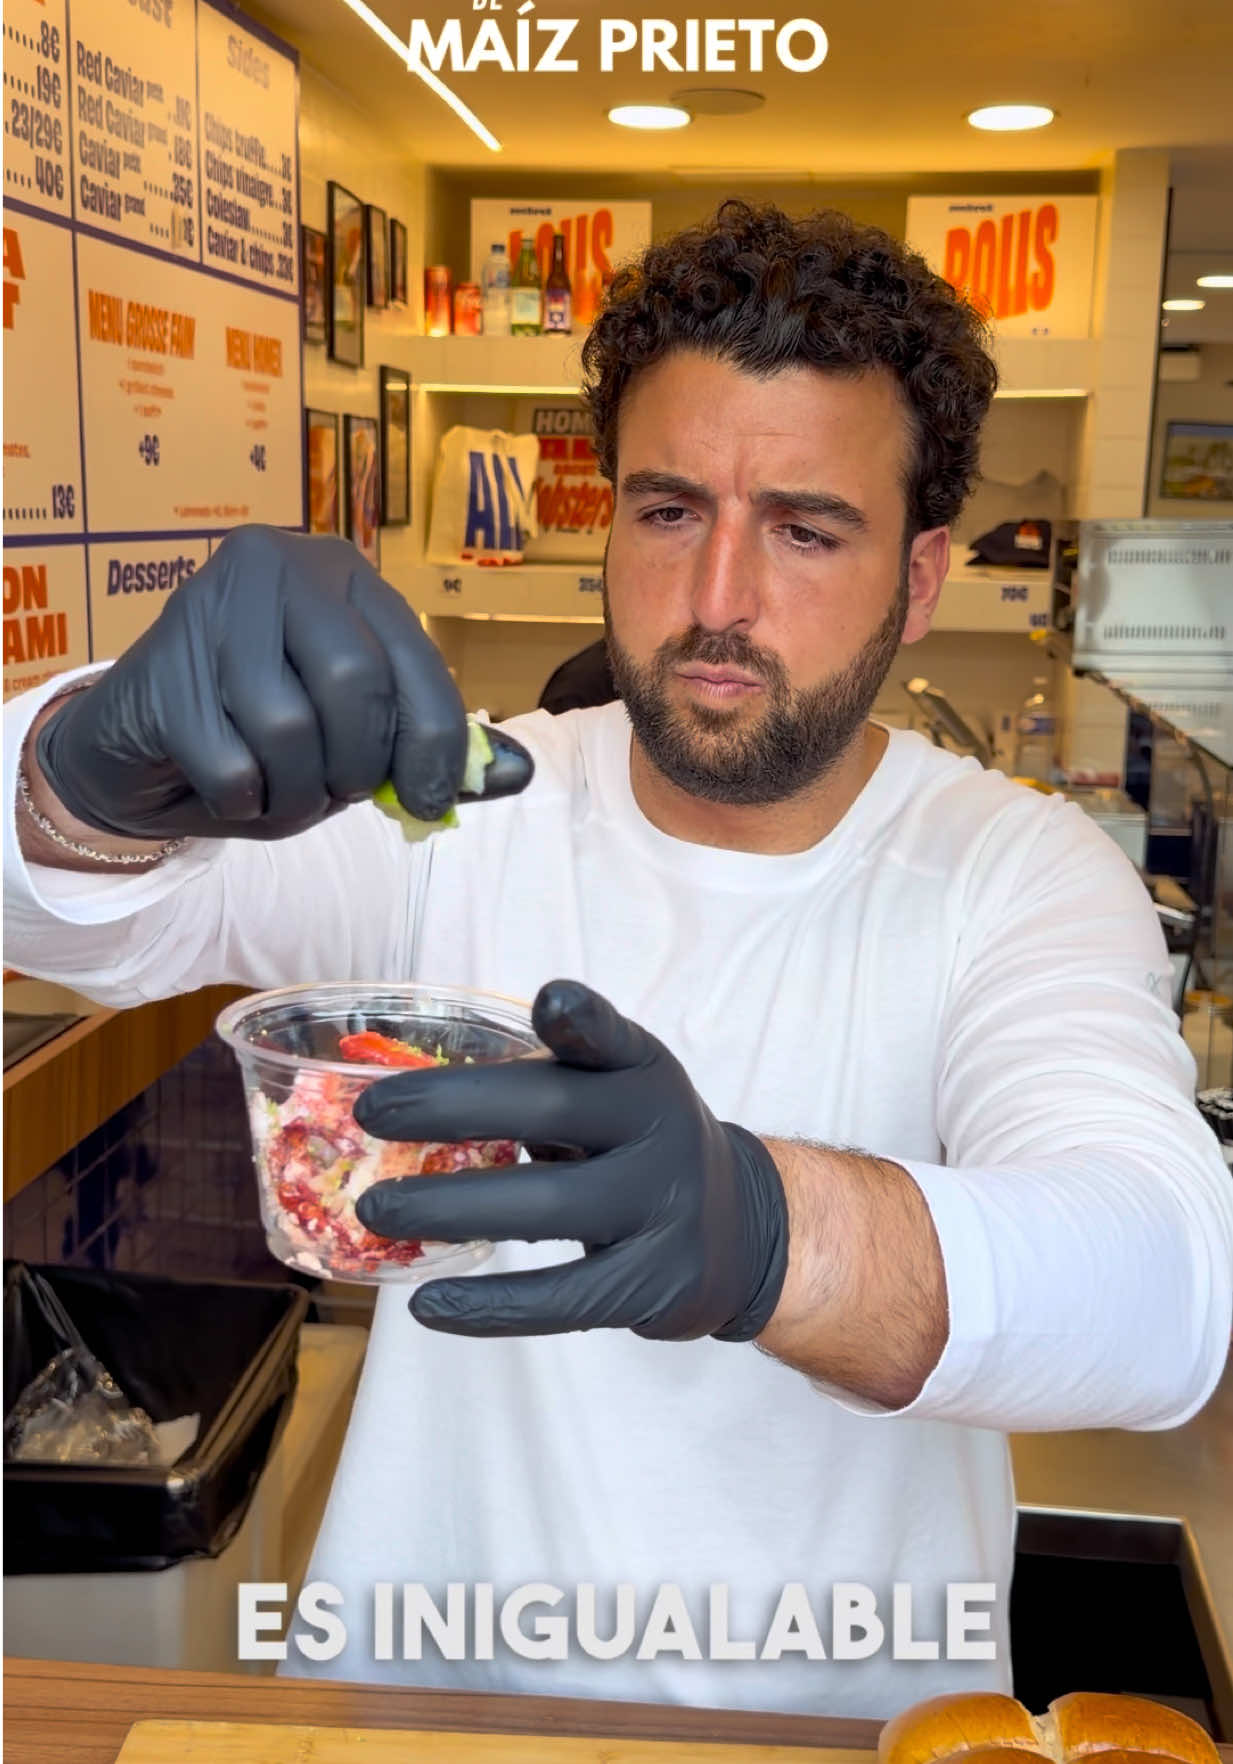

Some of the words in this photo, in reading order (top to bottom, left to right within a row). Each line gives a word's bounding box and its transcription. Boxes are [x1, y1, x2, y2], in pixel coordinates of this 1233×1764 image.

[77, 41, 102, 84] Red
[104, 57, 144, 108] Caviar
[78, 85, 103, 130] Red
[106, 100, 145, 149] Caviar
[79, 131, 120, 180] Caviar
[80, 175, 121, 221] Caviar
[208, 225, 238, 262] Caviar
[536, 411, 595, 433] HOM
[107, 555, 196, 597] Desserts
